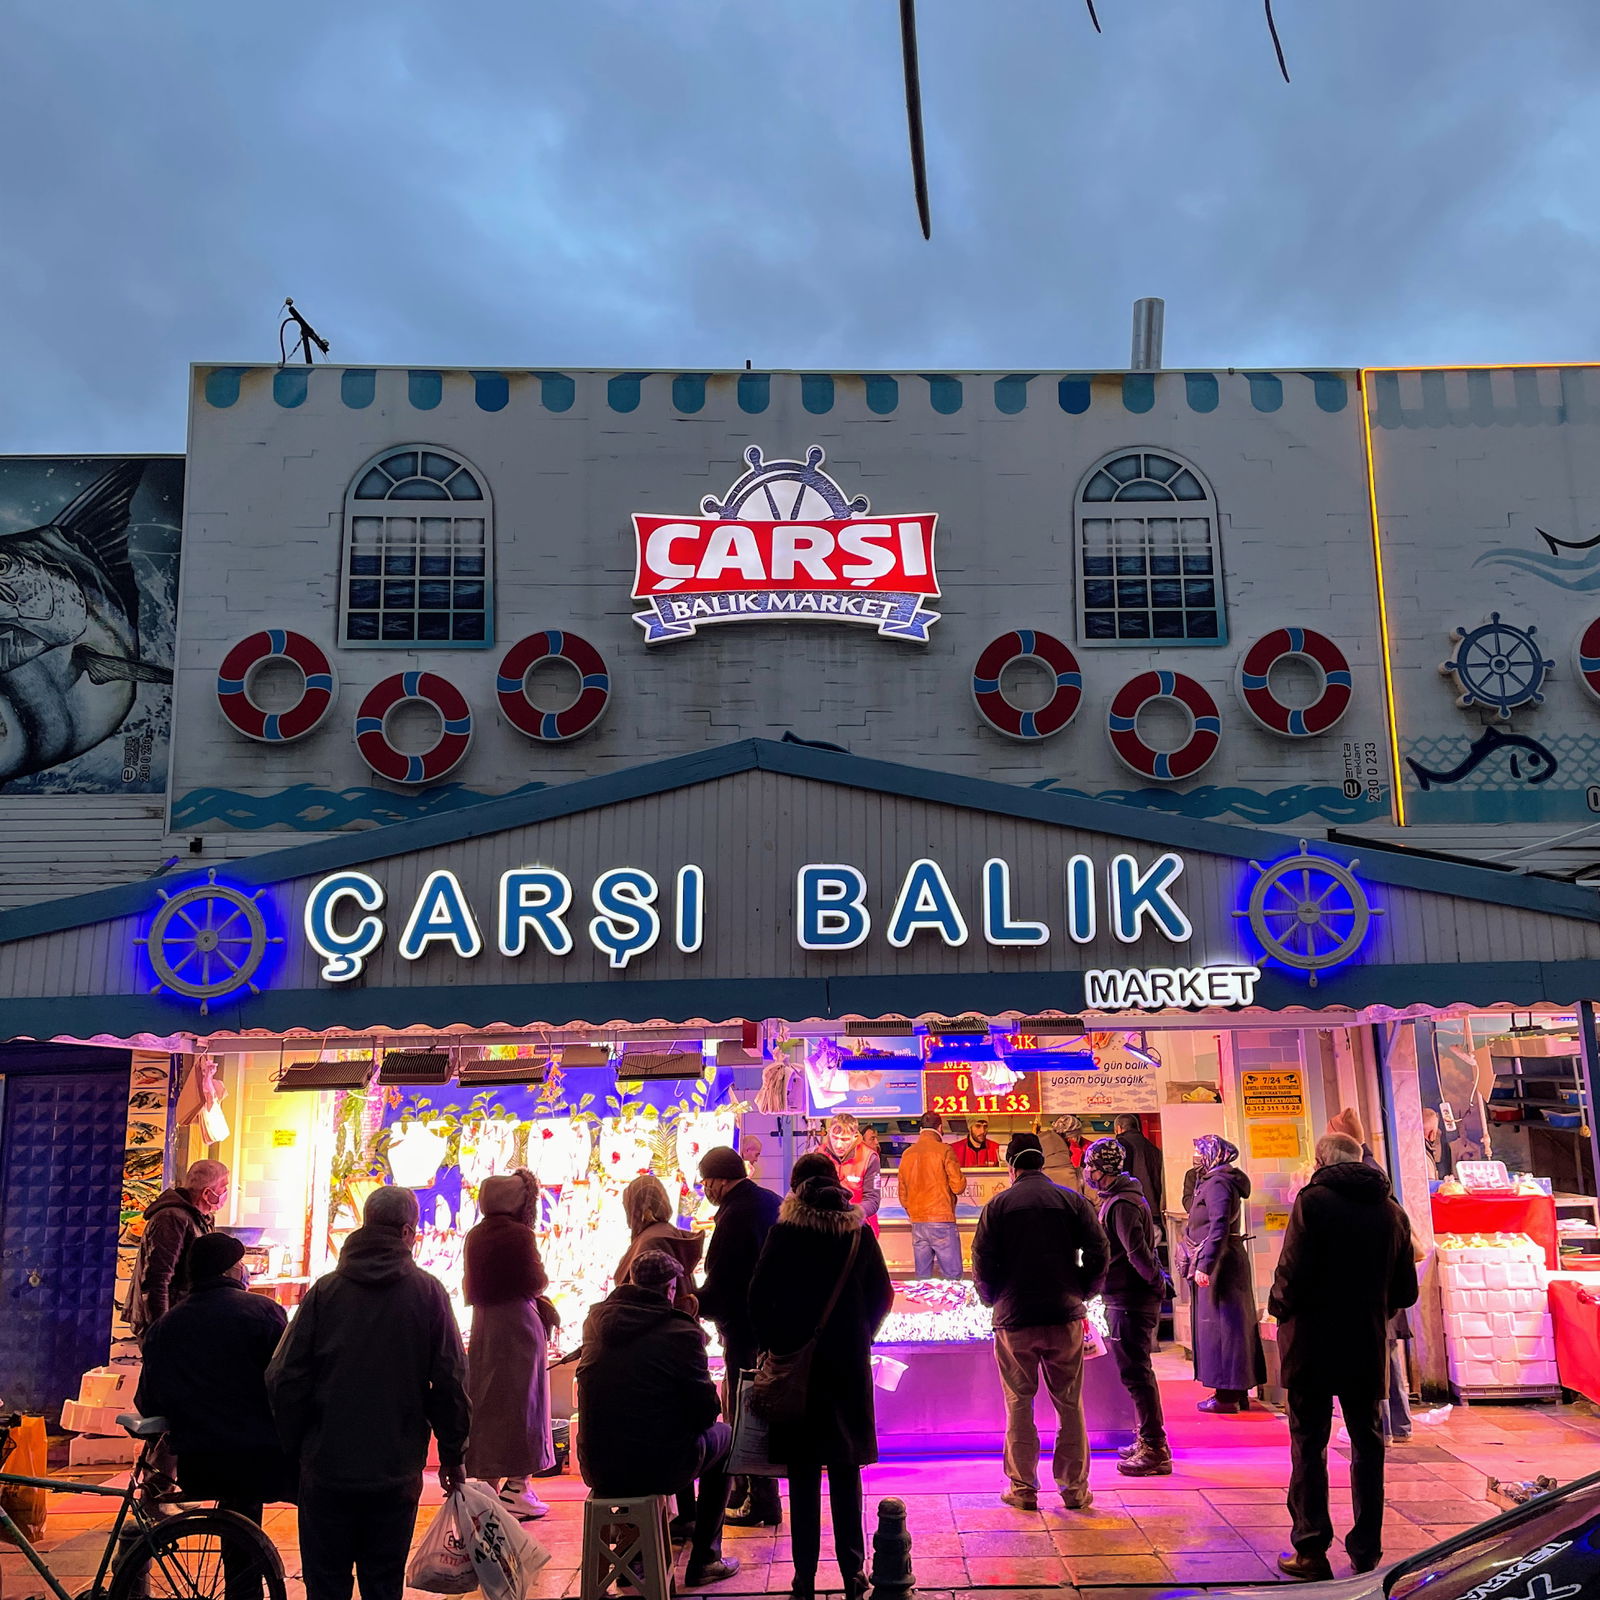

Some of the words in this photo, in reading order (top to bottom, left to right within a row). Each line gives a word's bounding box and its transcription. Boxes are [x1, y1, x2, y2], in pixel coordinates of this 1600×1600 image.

[646, 521, 927, 590] ÇARŞI
[670, 592, 762, 621] BALIK
[767, 592, 900, 620] MARKET
[1365, 742, 1377, 764] 233
[1368, 779, 1381, 801] 230
[304, 864, 704, 982] ÇARŞI
[797, 853, 1193, 951] BALIK
[1084, 966, 1261, 1009] MARKET
[1103, 1061, 1123, 1072] gün
[1051, 1075, 1085, 1087] yaşam
[1087, 1075, 1113, 1086] boyu
[1262, 1076, 1281, 1084] 7/24
[933, 1095, 970, 1112] 231
[977, 1095, 1000, 1112] 11
[1006, 1094, 1031, 1112] 33
